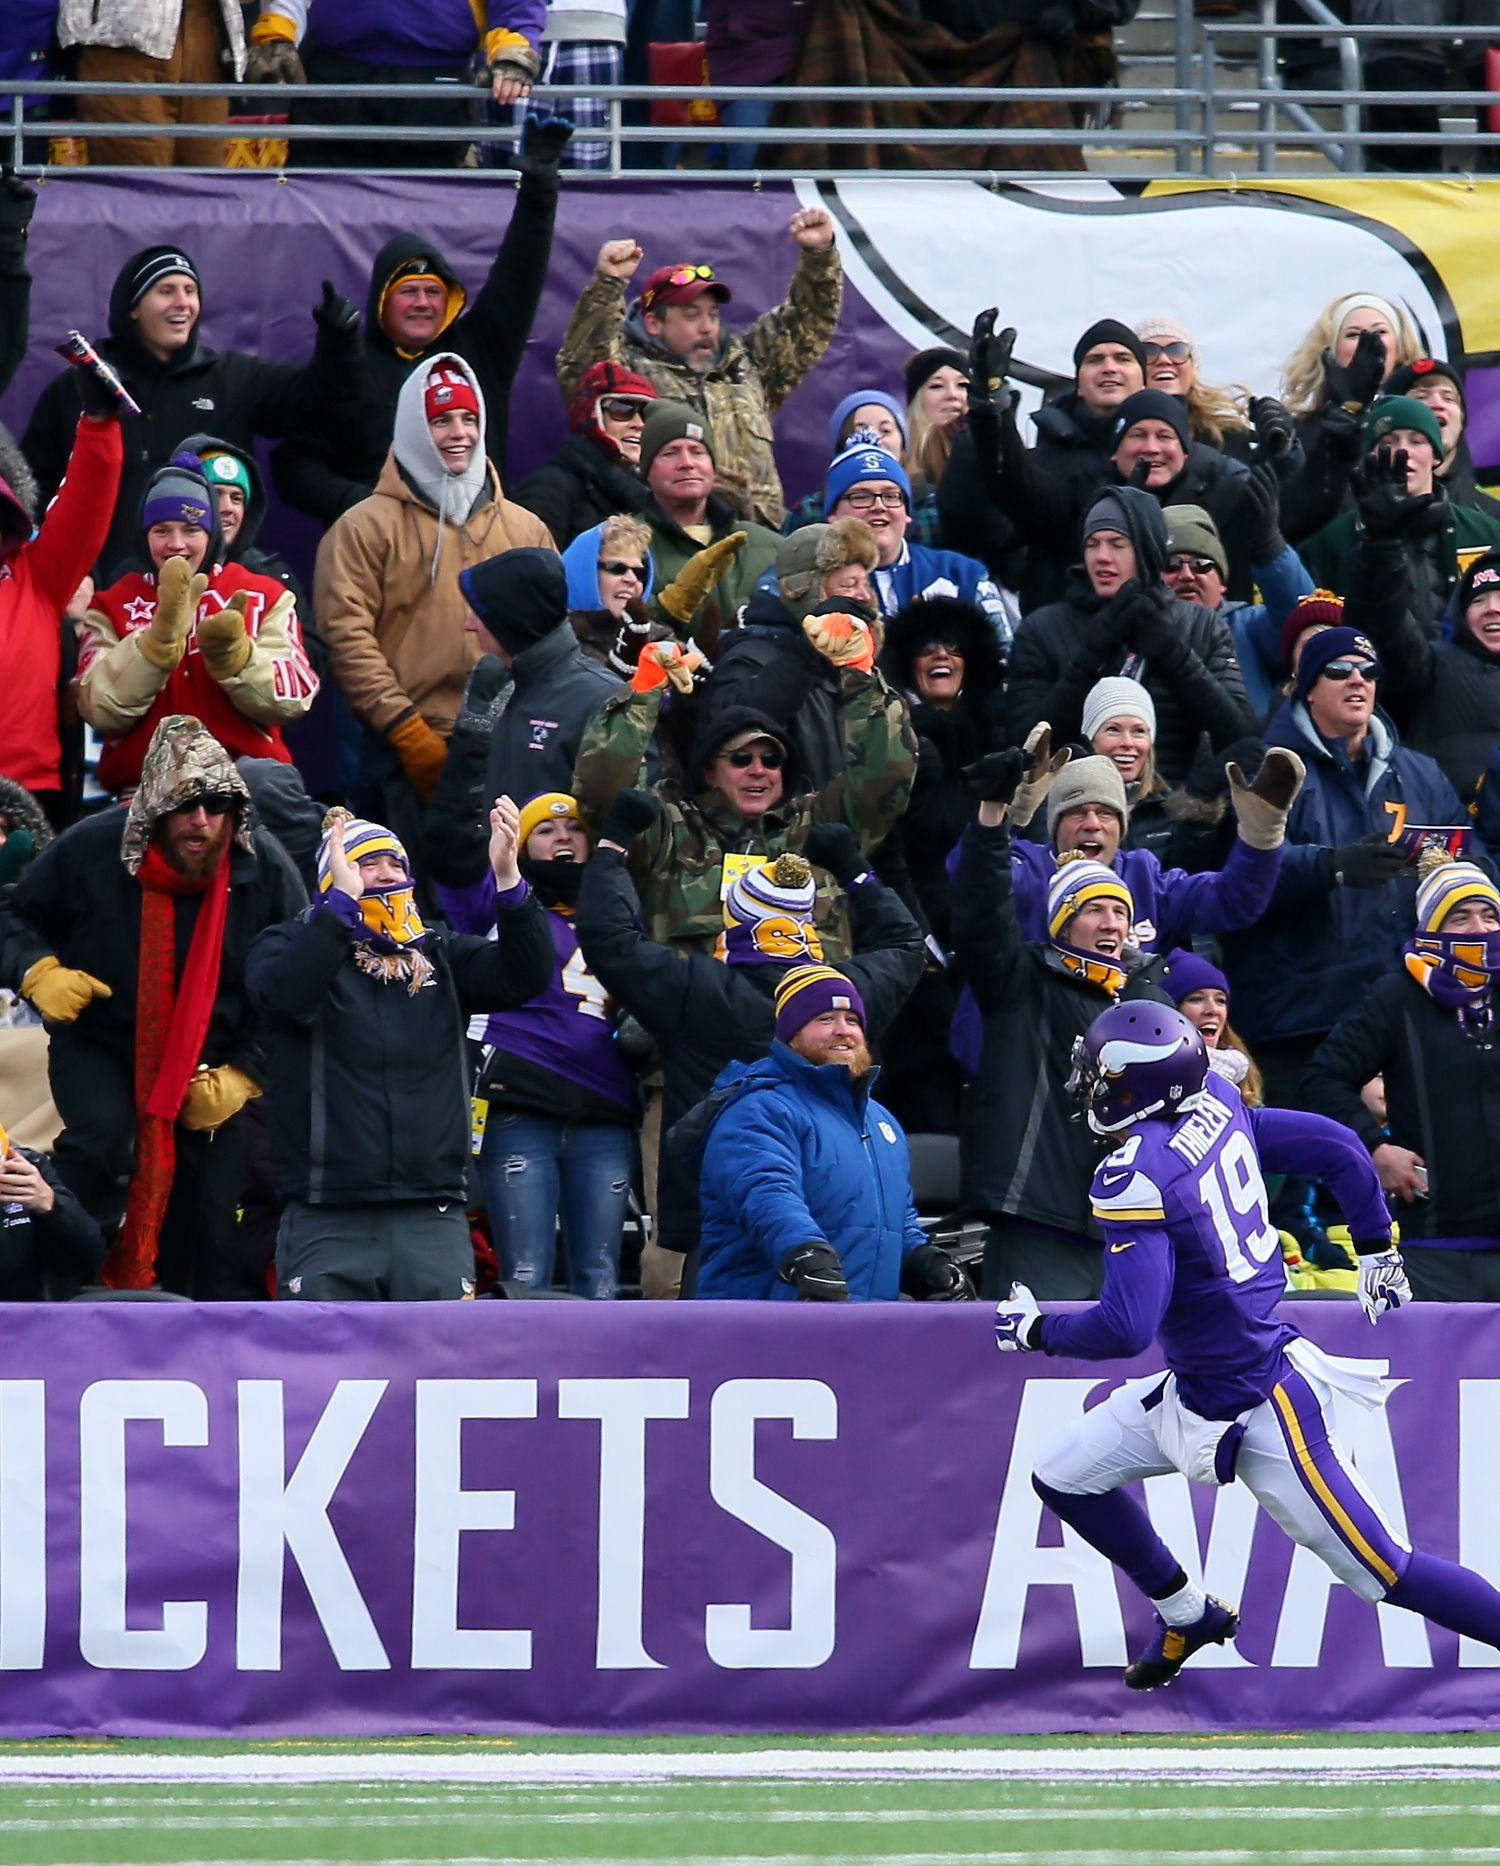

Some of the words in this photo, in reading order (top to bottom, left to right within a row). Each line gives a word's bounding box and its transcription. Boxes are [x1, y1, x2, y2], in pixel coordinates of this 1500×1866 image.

[1168, 1092, 1234, 1168] THIELEN
[1198, 1130, 1280, 1284] 19
[0, 1378, 838, 1671] ICKETS
